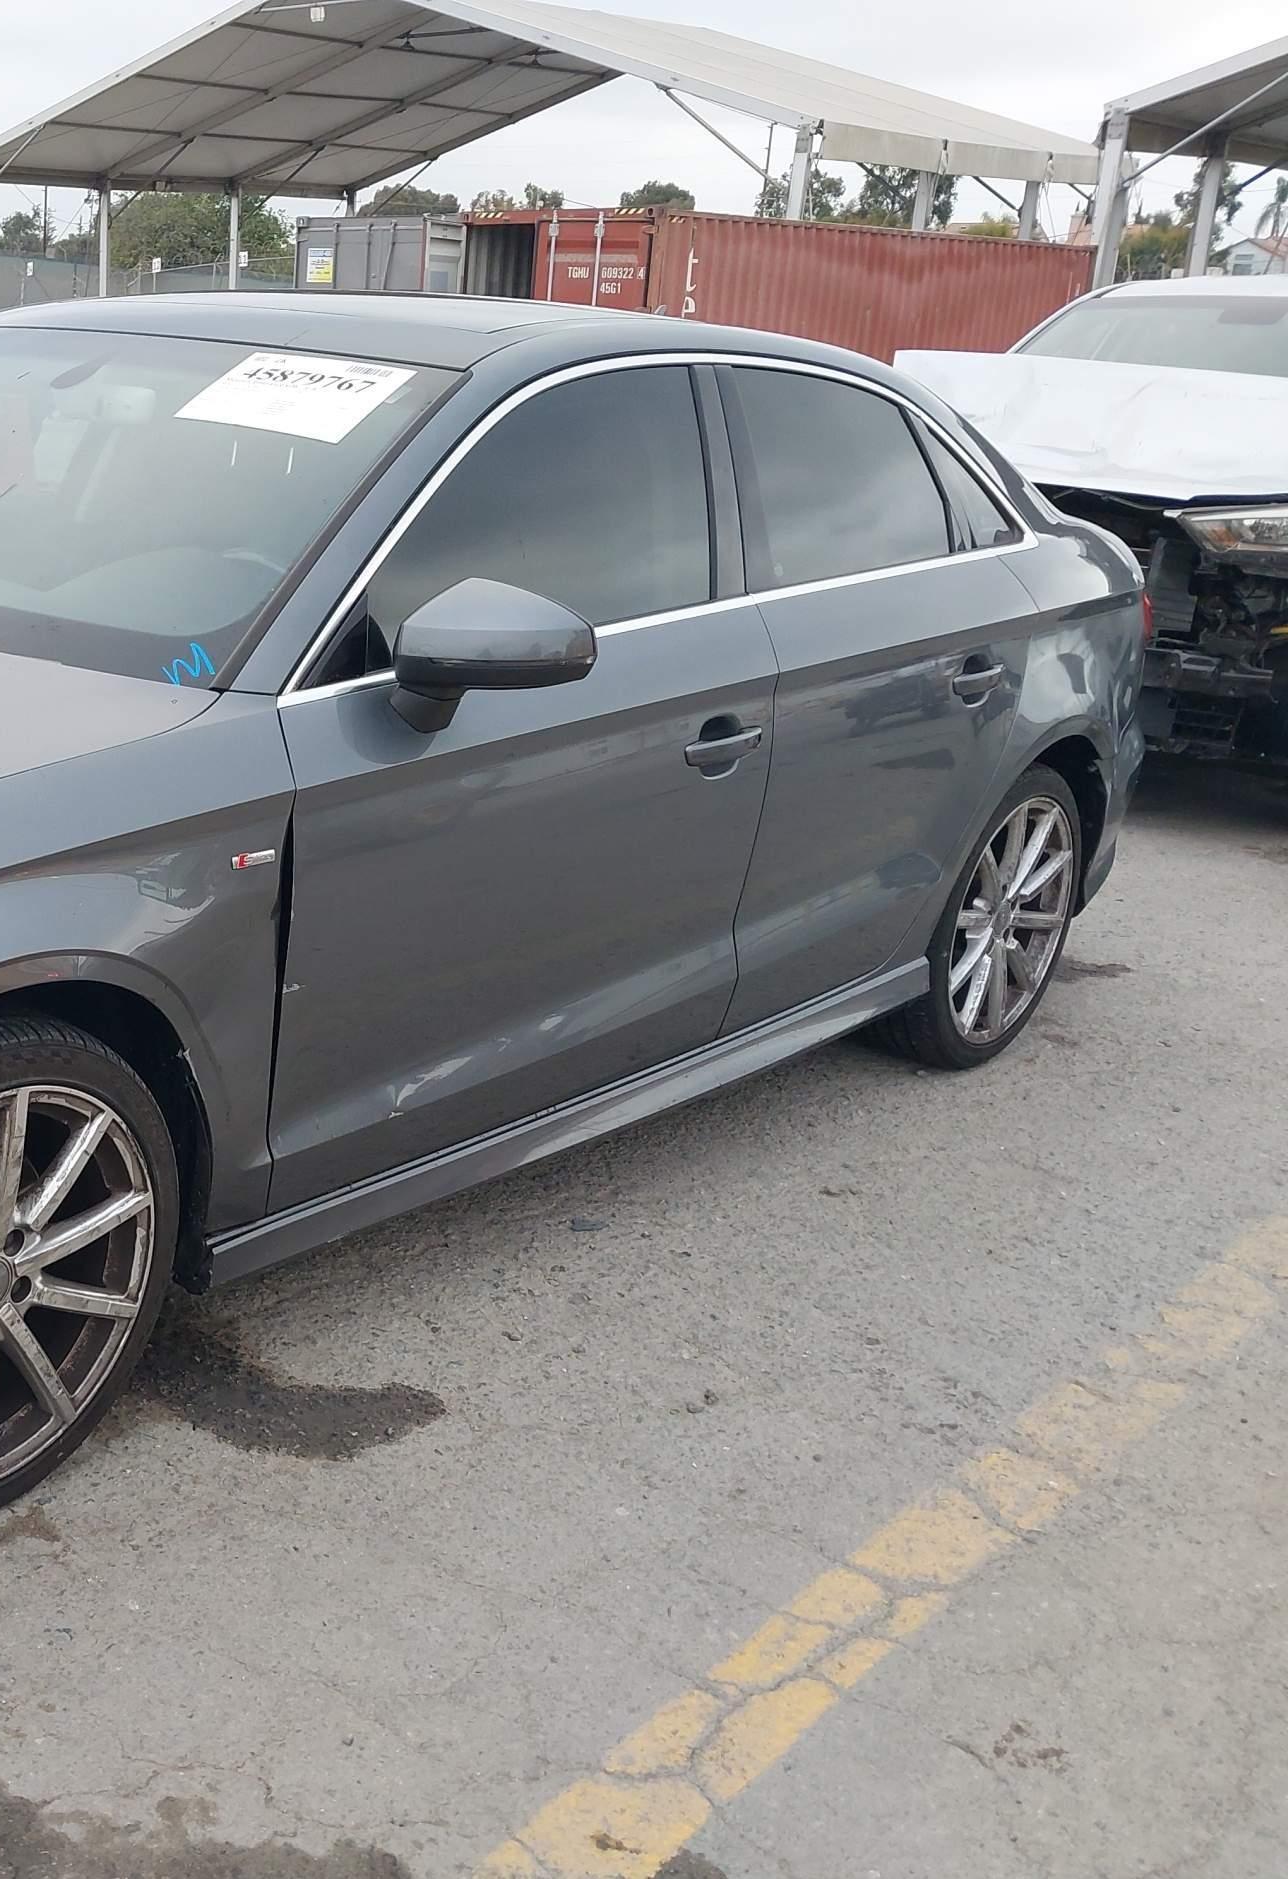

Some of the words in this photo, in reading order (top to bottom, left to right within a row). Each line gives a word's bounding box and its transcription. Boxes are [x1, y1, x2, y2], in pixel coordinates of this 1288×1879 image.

[567, 266, 590, 279] TGHU
[601, 266, 634, 279] 609322
[600, 282, 622, 294] 45G1
[243, 367, 377, 393] 45879767
